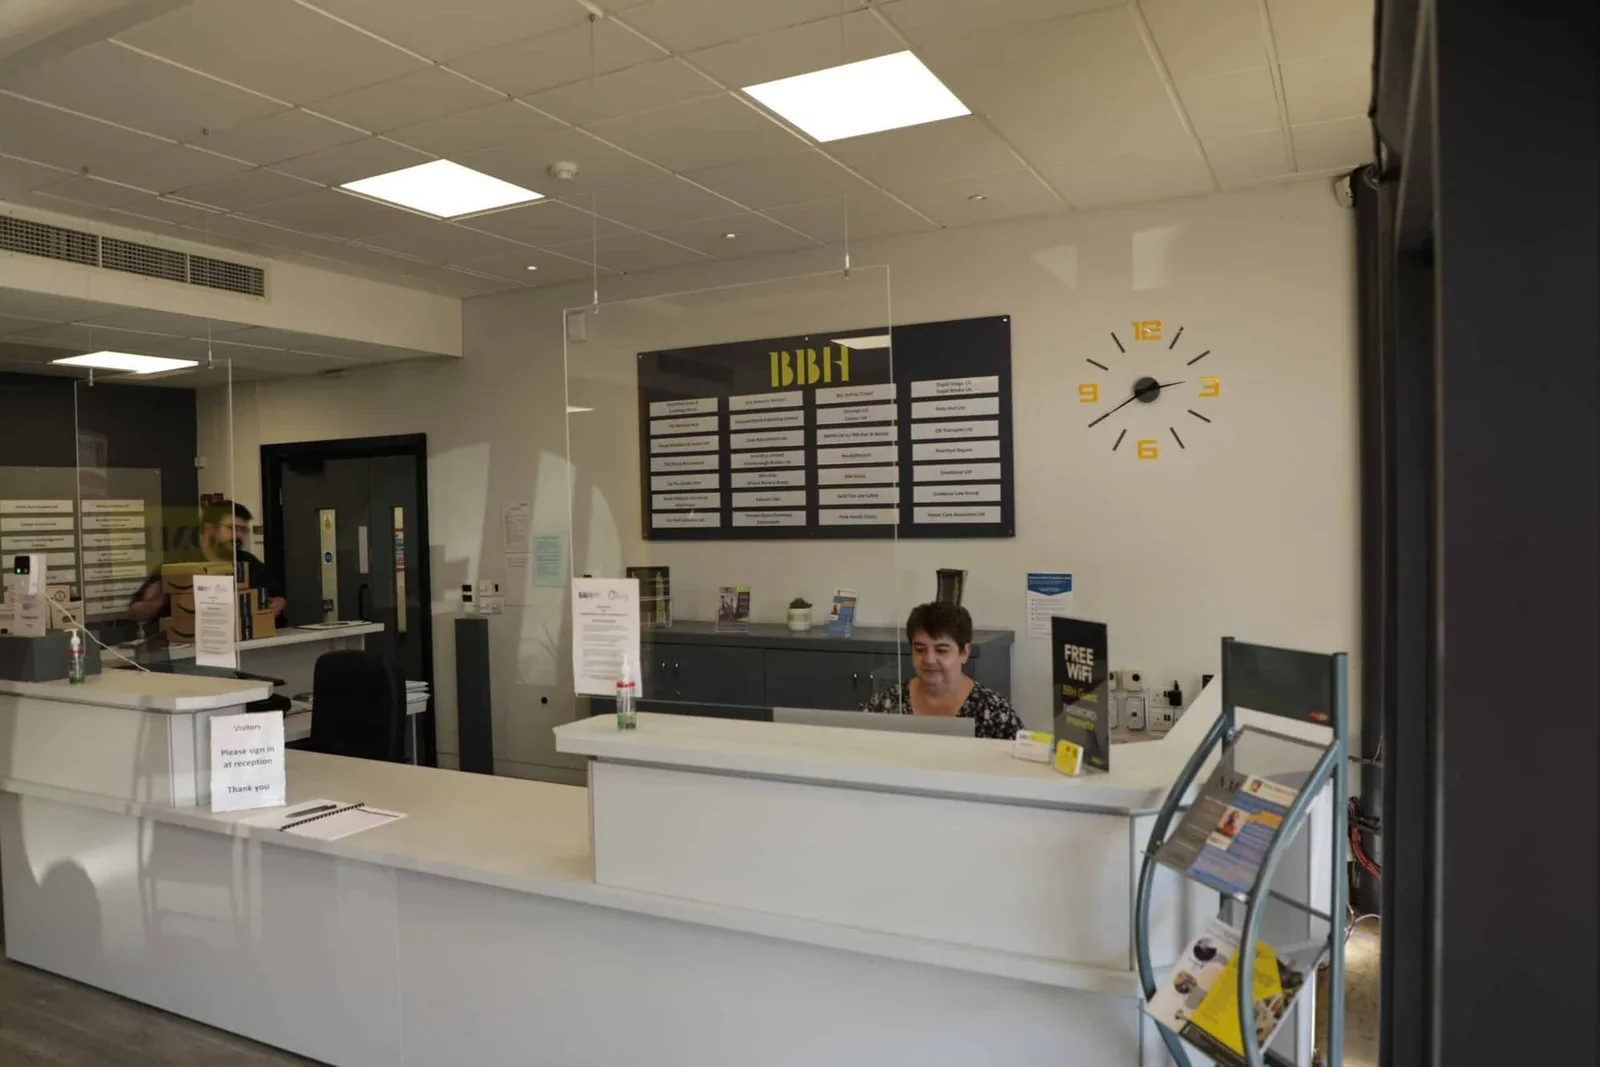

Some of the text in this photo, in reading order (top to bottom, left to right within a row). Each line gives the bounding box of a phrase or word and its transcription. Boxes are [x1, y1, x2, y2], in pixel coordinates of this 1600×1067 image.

[1132, 320, 1162, 340] 12
[768, 345, 850, 388] BBH
[1078, 384, 1098, 403] 9
[1198, 376, 1220, 398] 3
[1138, 440, 1158, 460] 6
[1064, 644, 1094, 666] FREE
[1066, 662, 1092, 684] WiFi
[234, 724, 261, 732] Visitors
[221, 748, 247, 756] Please
[249, 747, 266, 755] sign
[223, 758, 272, 768] at reception
[228, 784, 270, 794] Thank you
